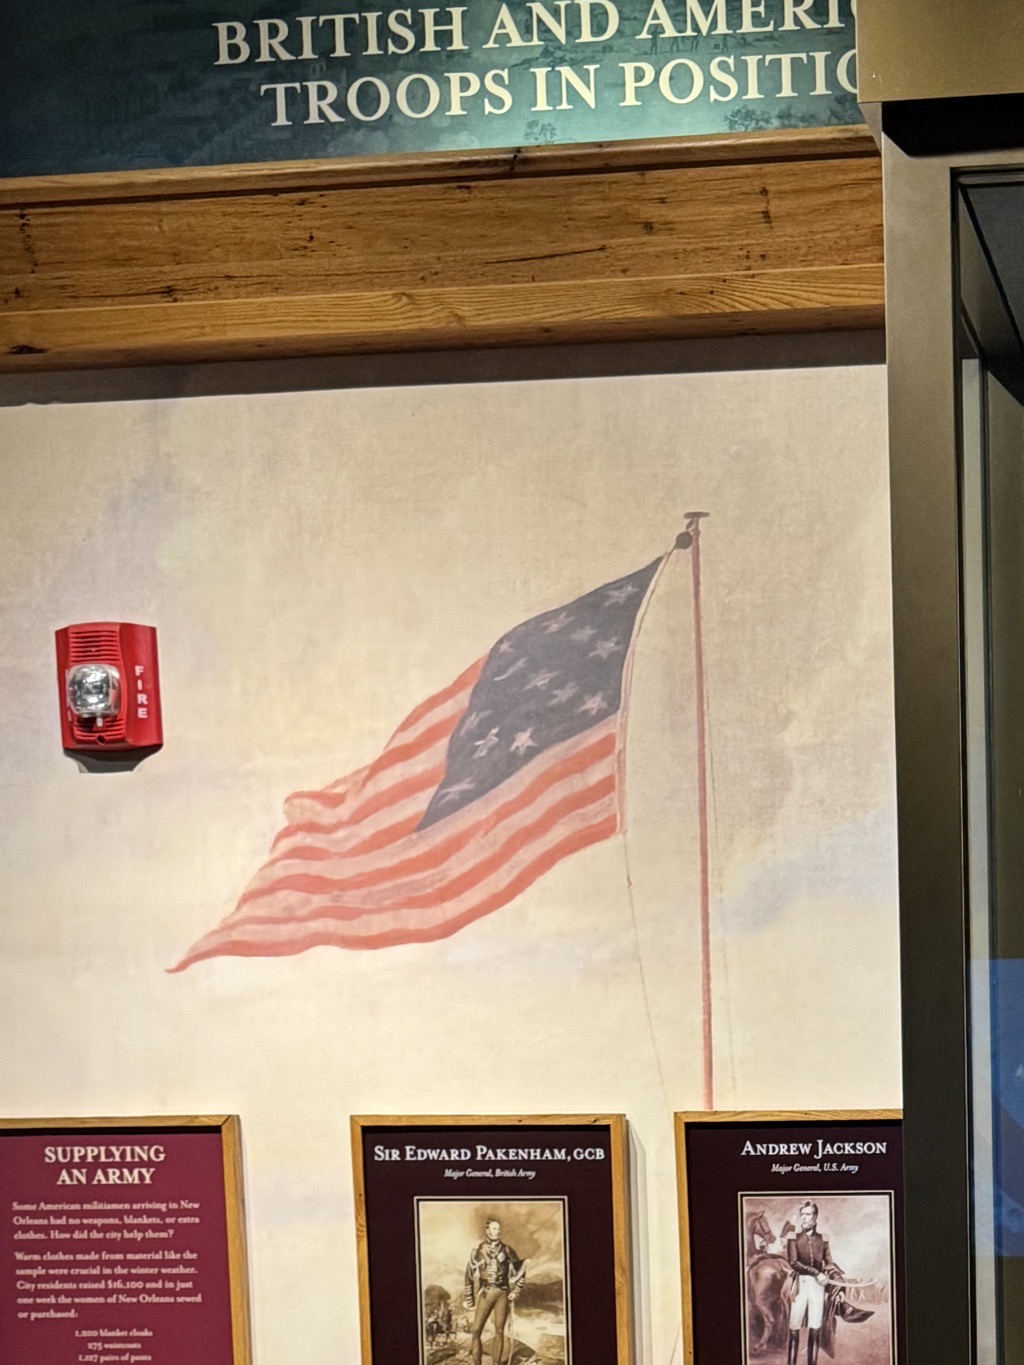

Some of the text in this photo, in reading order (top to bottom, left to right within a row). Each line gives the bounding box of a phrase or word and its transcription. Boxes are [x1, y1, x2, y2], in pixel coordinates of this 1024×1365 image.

[212, 0, 858, 65] BRITISH AND AMERI
[260, 68, 513, 127] TROOPS
[530, 64, 600, 112] IN
[134, 665, 148, 719] FIRE
[44, 1145, 166, 1162] SUPPLYING
[57, 1168, 155, 1184] AN ARMY
